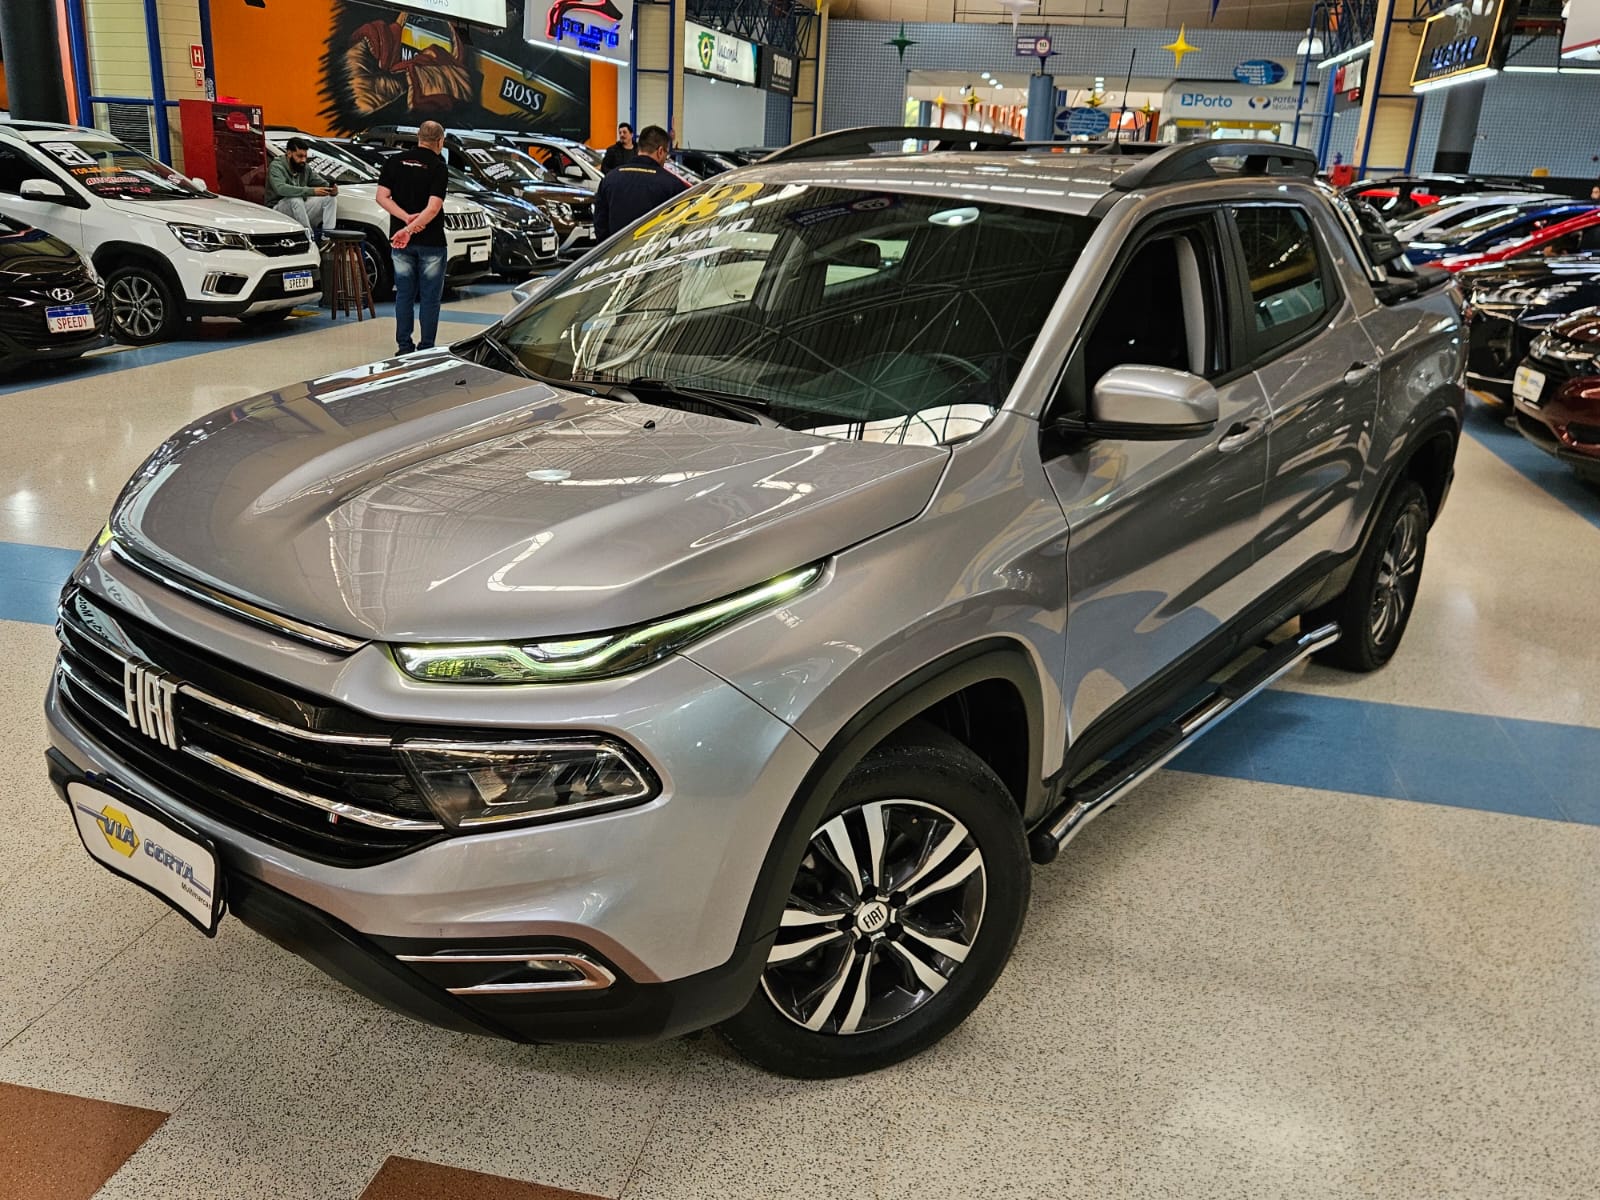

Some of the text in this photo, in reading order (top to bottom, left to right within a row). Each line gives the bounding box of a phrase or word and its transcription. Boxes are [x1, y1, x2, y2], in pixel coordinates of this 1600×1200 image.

[193, 49, 202, 64] H
[502, 78, 541, 111] BOSS
[1194, 94, 1233, 108] Porto
[1272, 95, 1309, 105] POTÊNA
[633, 182, 765, 241] 23
[659, 218, 754, 250] NOVO
[289, 278, 309, 289] SPEEDY
[57, 315, 88, 330] SPEEDY
[124, 659, 178, 750] FIAT
[103, 817, 136, 848] VIA
[143, 838, 195, 882] CERTA
[862, 905, 885, 929] FIAT
